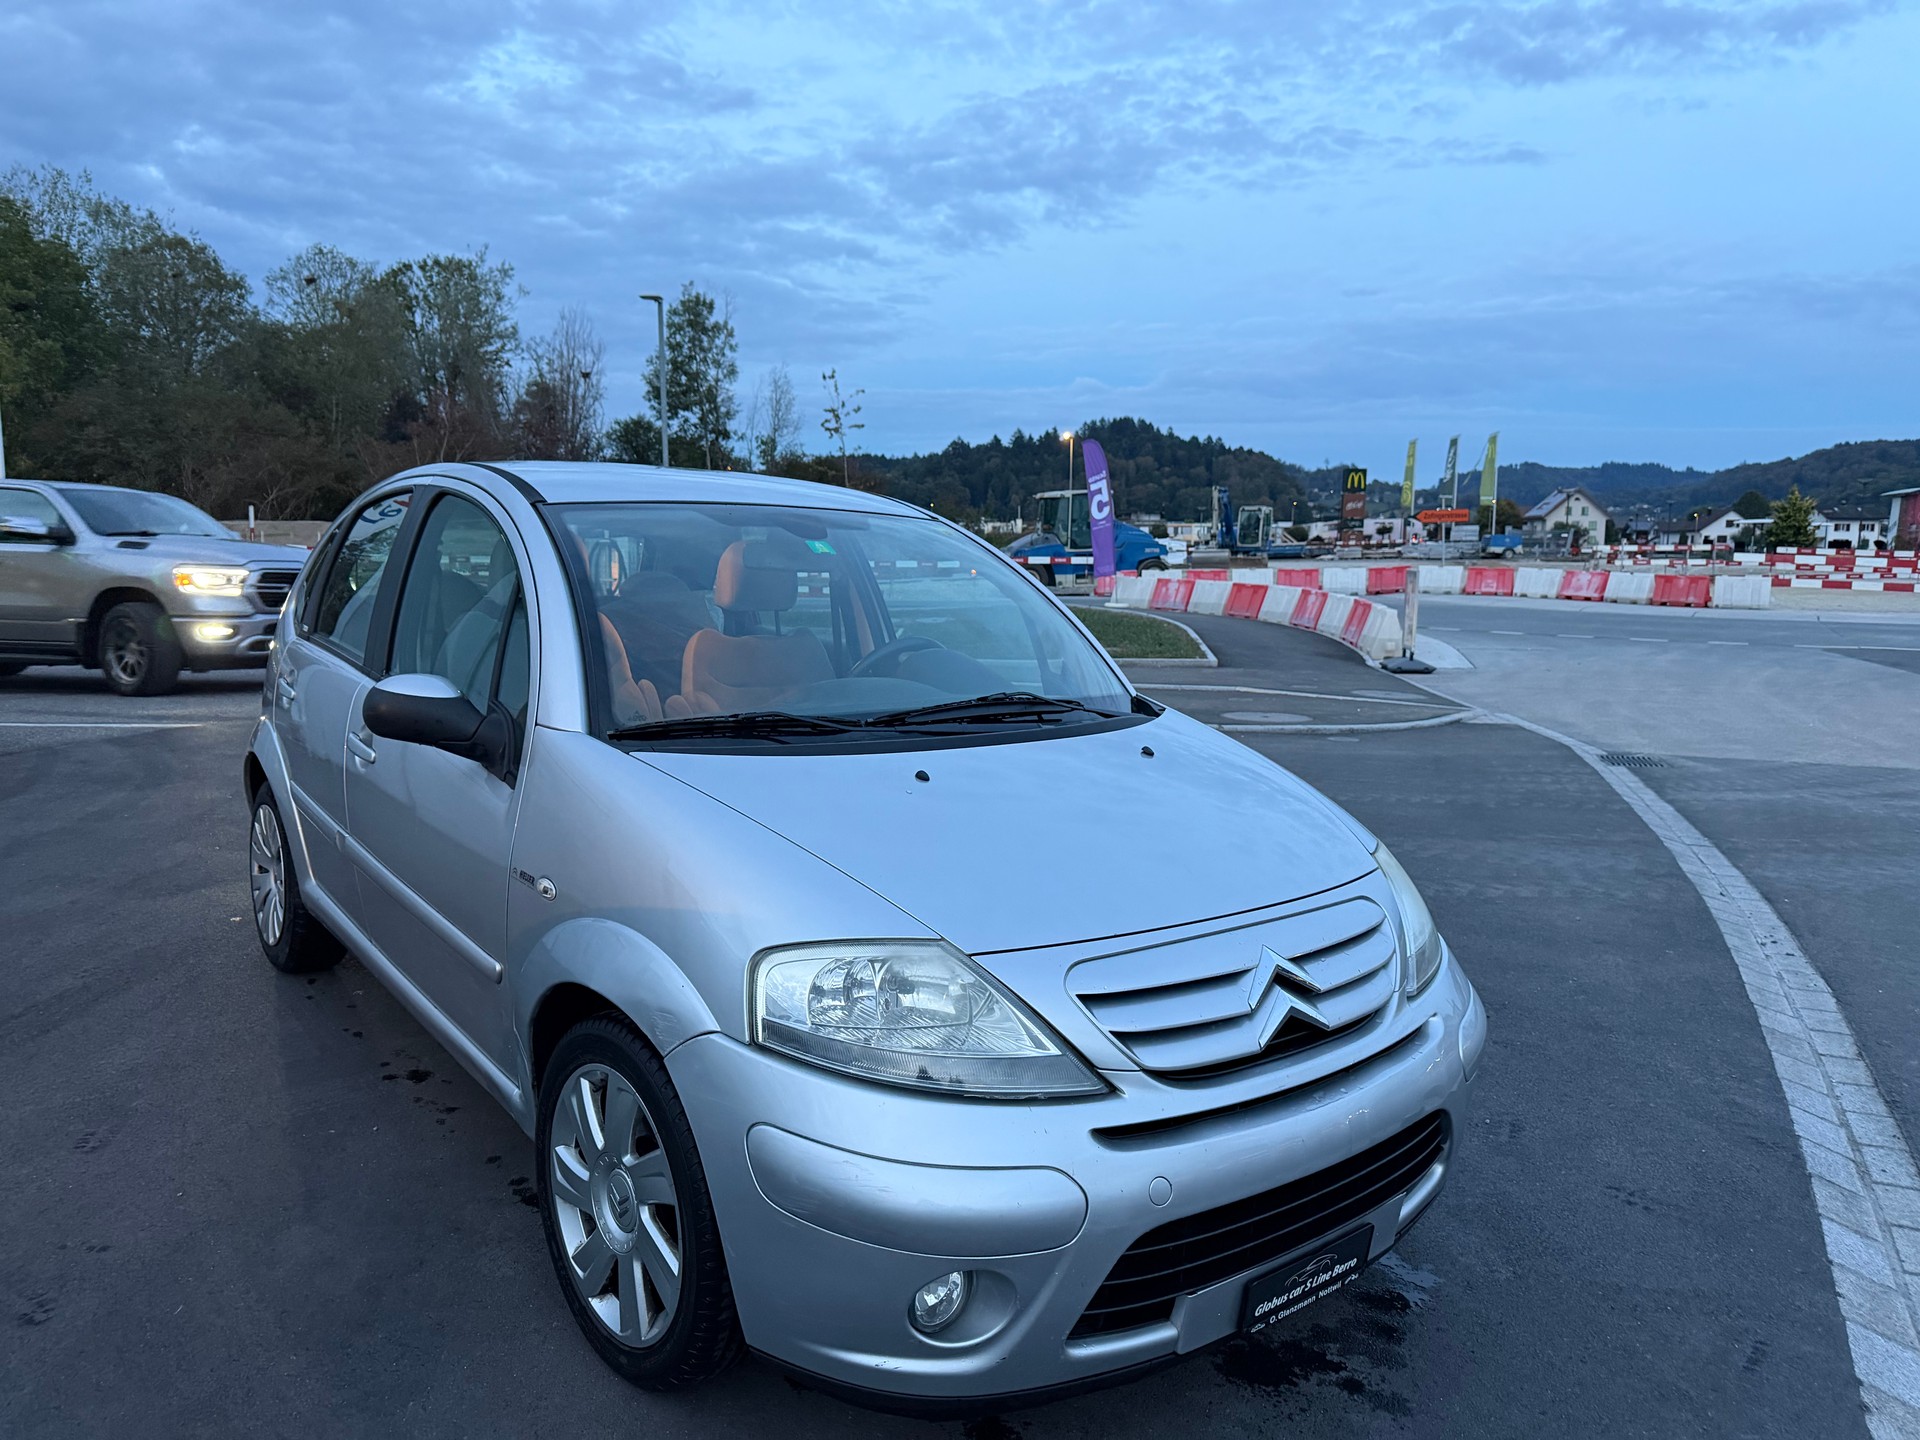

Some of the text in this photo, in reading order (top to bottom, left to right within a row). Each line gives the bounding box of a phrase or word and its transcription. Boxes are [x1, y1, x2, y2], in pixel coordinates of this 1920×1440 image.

[1254, 1257, 1357, 1317] Globus car S Line Berro
[1269, 1281, 1342, 1324] O. Glanzmann Nottwil
